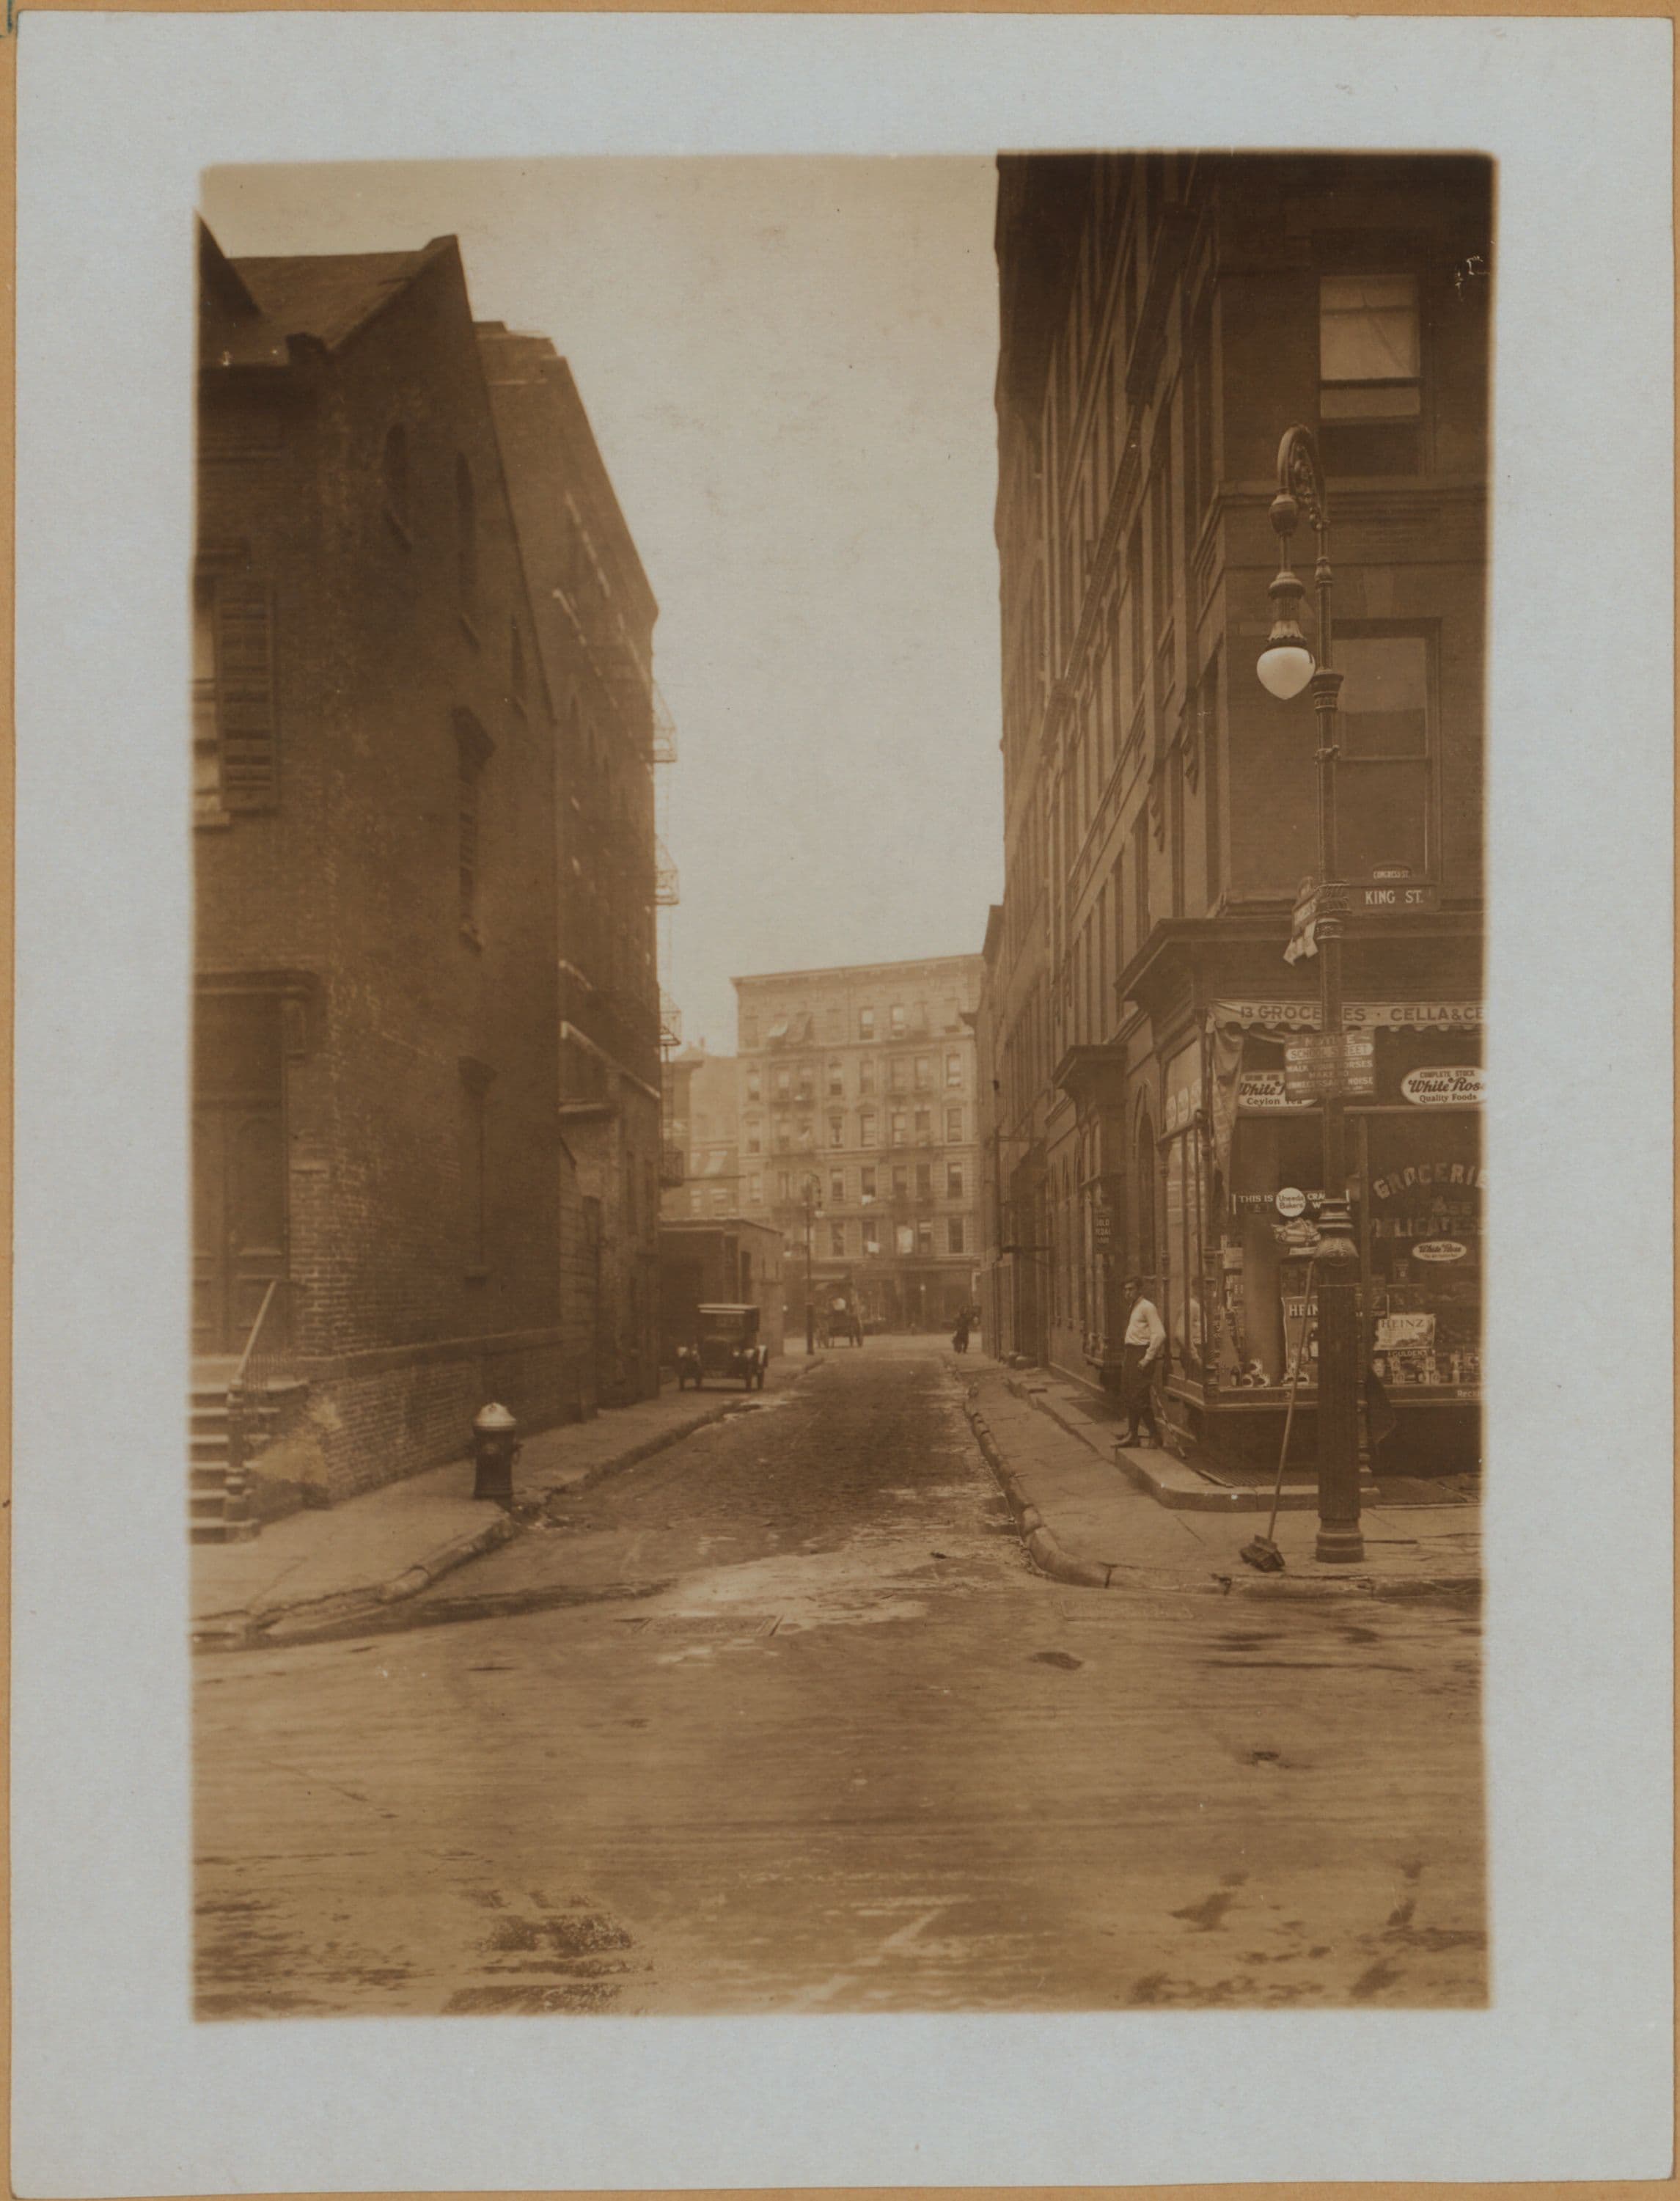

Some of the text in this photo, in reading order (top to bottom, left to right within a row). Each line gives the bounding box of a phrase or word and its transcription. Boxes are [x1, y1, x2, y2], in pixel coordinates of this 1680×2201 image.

[1365, 889, 1424, 904] KING ST.
[1258, 1006, 1366, 1022] GROCEES
[1305, 1033, 1355, 1046] NTIE
[1331, 1045, 1369, 1057] SREET
[1348, 1077, 1373, 1085] NOISE
[1408, 1079, 1449, 1093] White
[1247, 1096, 1280, 1107] Ceylon
[1420, 1094, 1449, 1103] Quality
[1239, 1193, 1274, 1203] THIS IS
[1380, 1319, 1425, 1329] HEINZ
